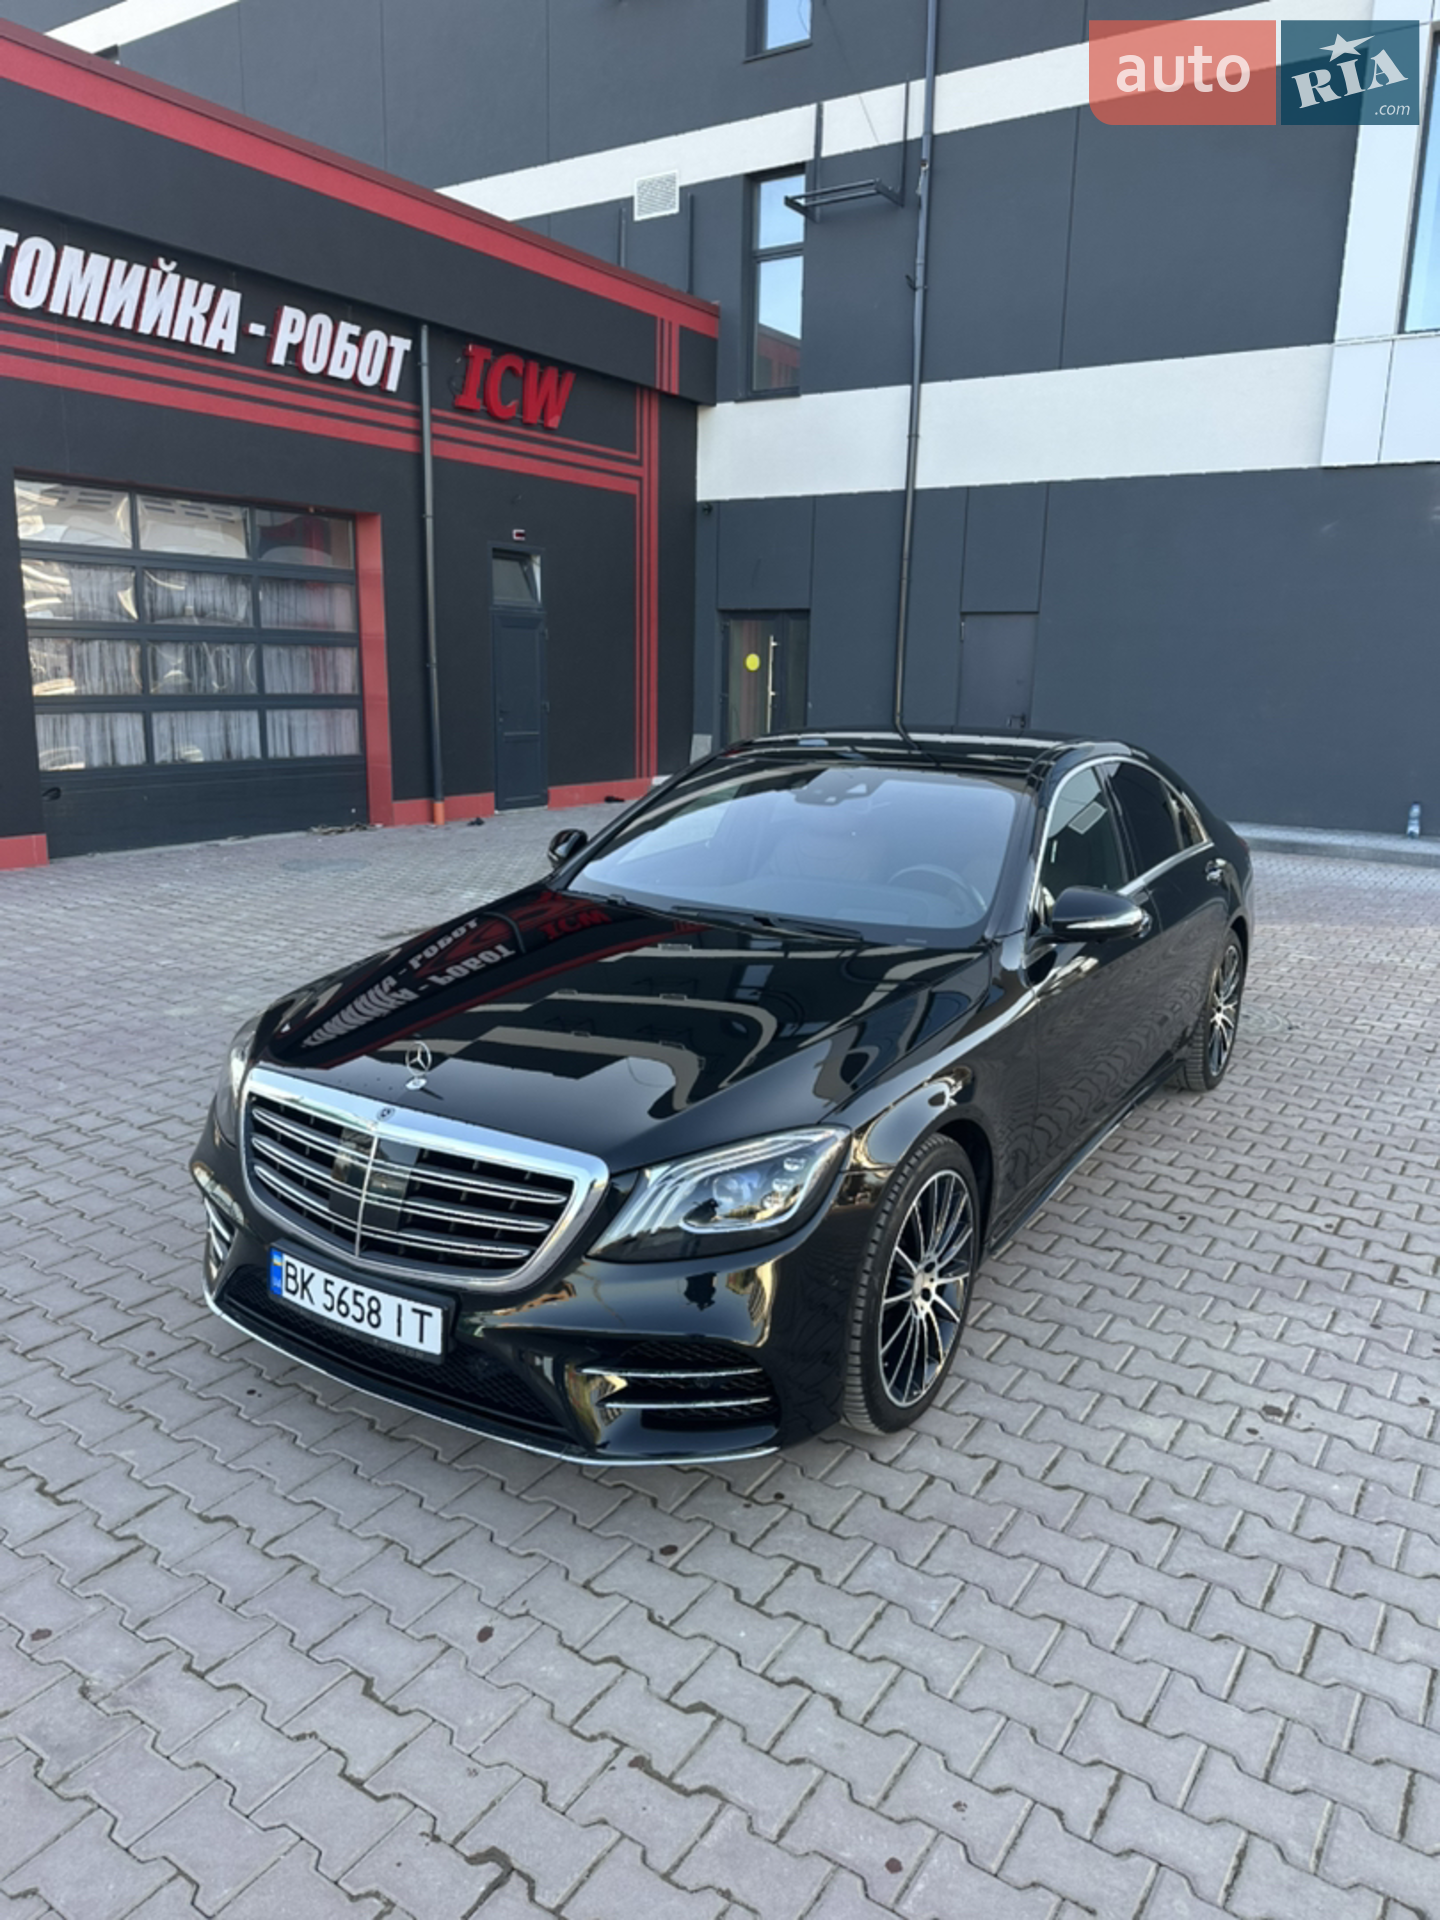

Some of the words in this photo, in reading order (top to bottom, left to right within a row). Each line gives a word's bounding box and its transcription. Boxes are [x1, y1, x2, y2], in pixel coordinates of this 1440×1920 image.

[270, 304, 413, 393] РОБОТ
[453, 343, 576, 431] ICW
[284, 1260, 316, 1306] BK
[322, 1277, 383, 1330] 5658
[396, 1303, 434, 1344] IT
